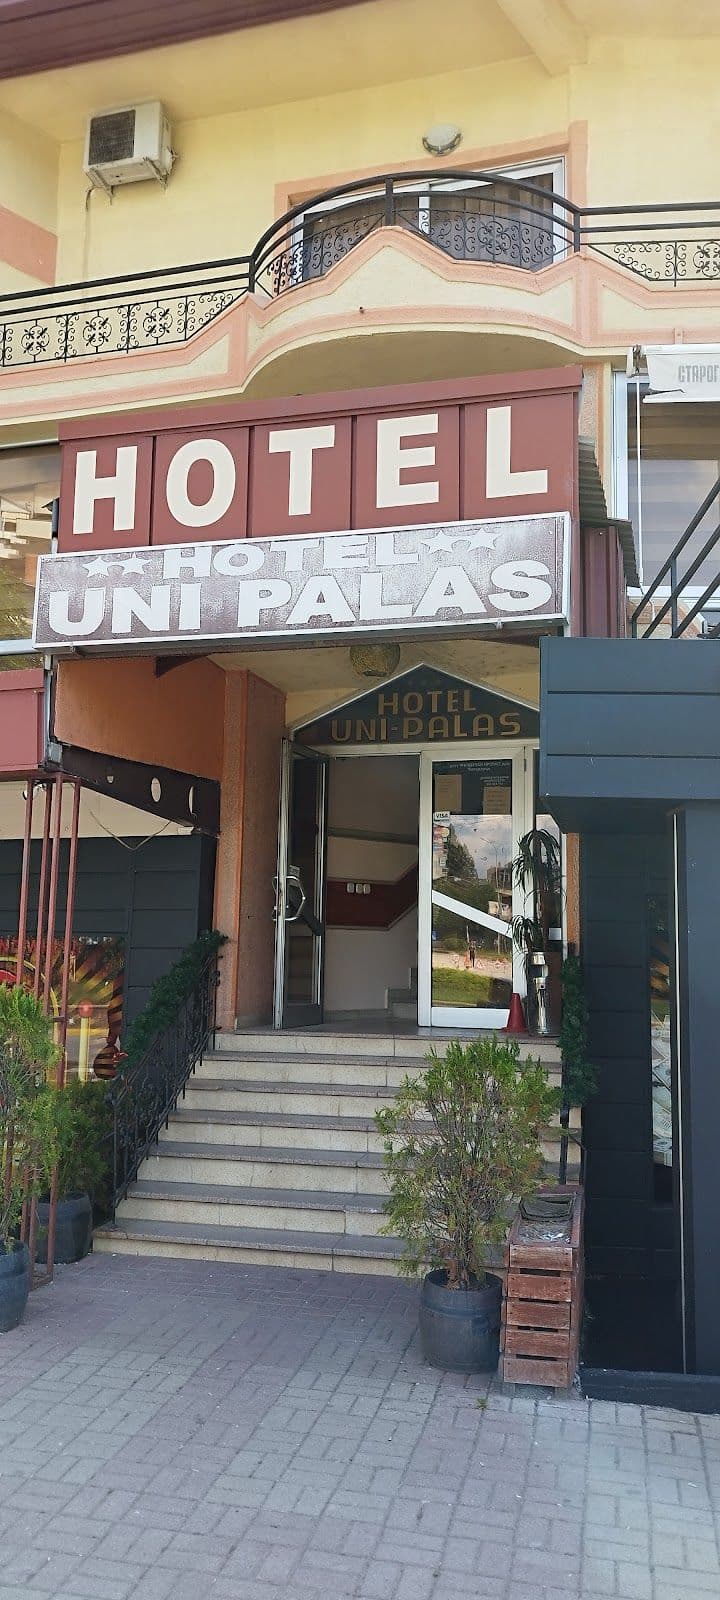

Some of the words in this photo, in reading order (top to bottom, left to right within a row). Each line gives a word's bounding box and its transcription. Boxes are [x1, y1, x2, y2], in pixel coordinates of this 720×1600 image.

[73, 406, 549, 535] HOTEL
[163, 533, 419, 579] HOTEL
[48, 583, 201, 635] UNI
[236, 560, 553, 628] PALAS
[378, 689, 476, 715] HOTEL
[331, 712, 521, 742] UNI-PALAS
